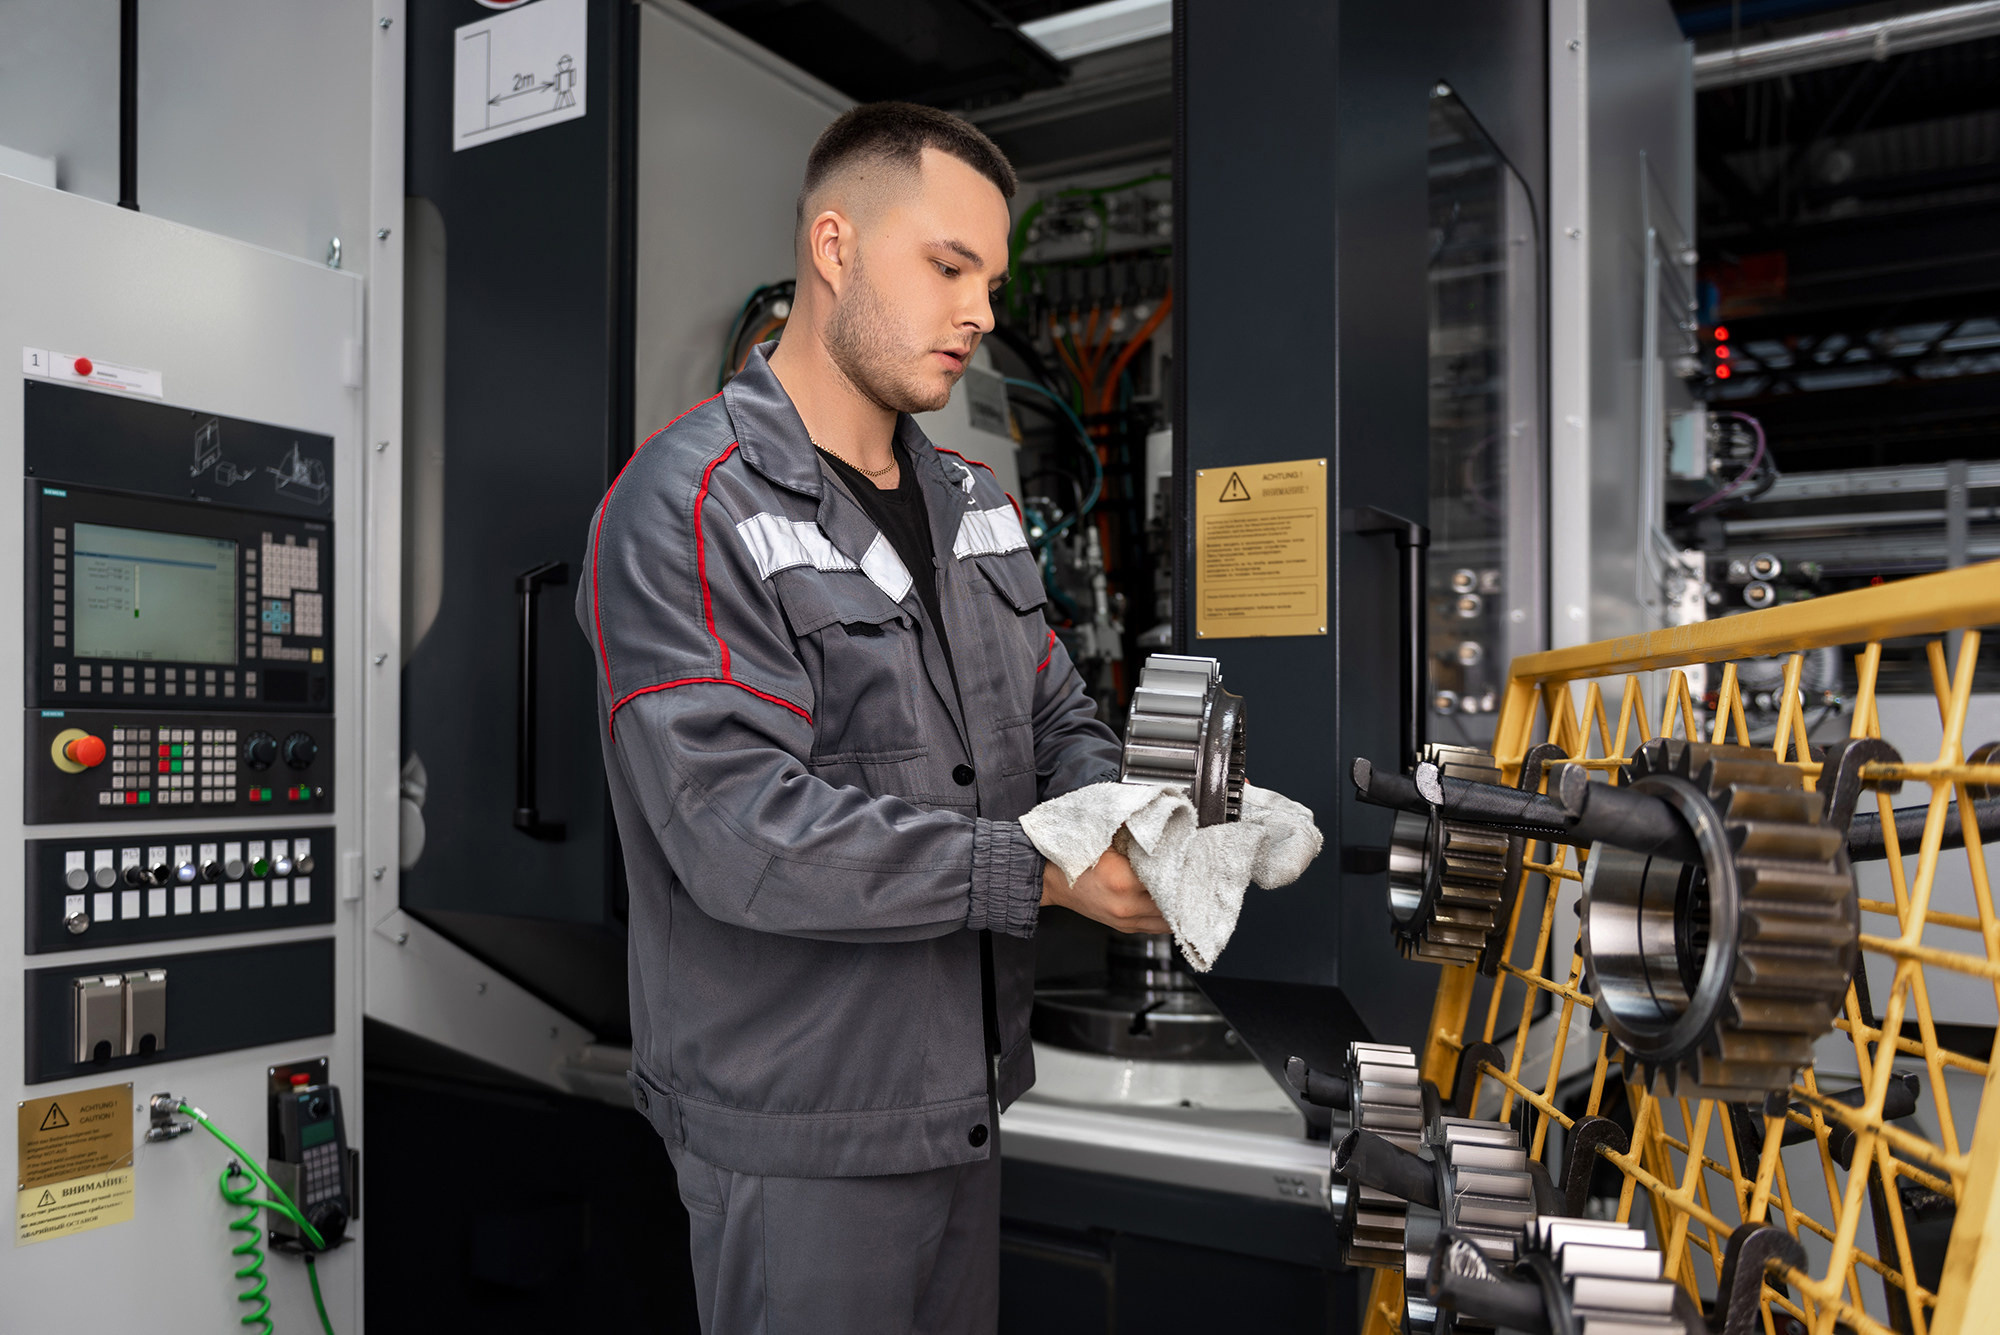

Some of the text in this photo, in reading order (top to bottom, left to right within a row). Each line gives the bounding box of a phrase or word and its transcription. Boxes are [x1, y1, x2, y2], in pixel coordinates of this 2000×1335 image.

[512, 73, 535, 91] 2m
[32, 353, 40, 367] 1
[1262, 471, 1299, 481] ACHTUNG
[80, 1102, 114, 1113] ACHTUNG
[80, 1113, 111, 1124] CAUTION
[61, 1175, 128, 1198] ВНИМАНИЕ!
